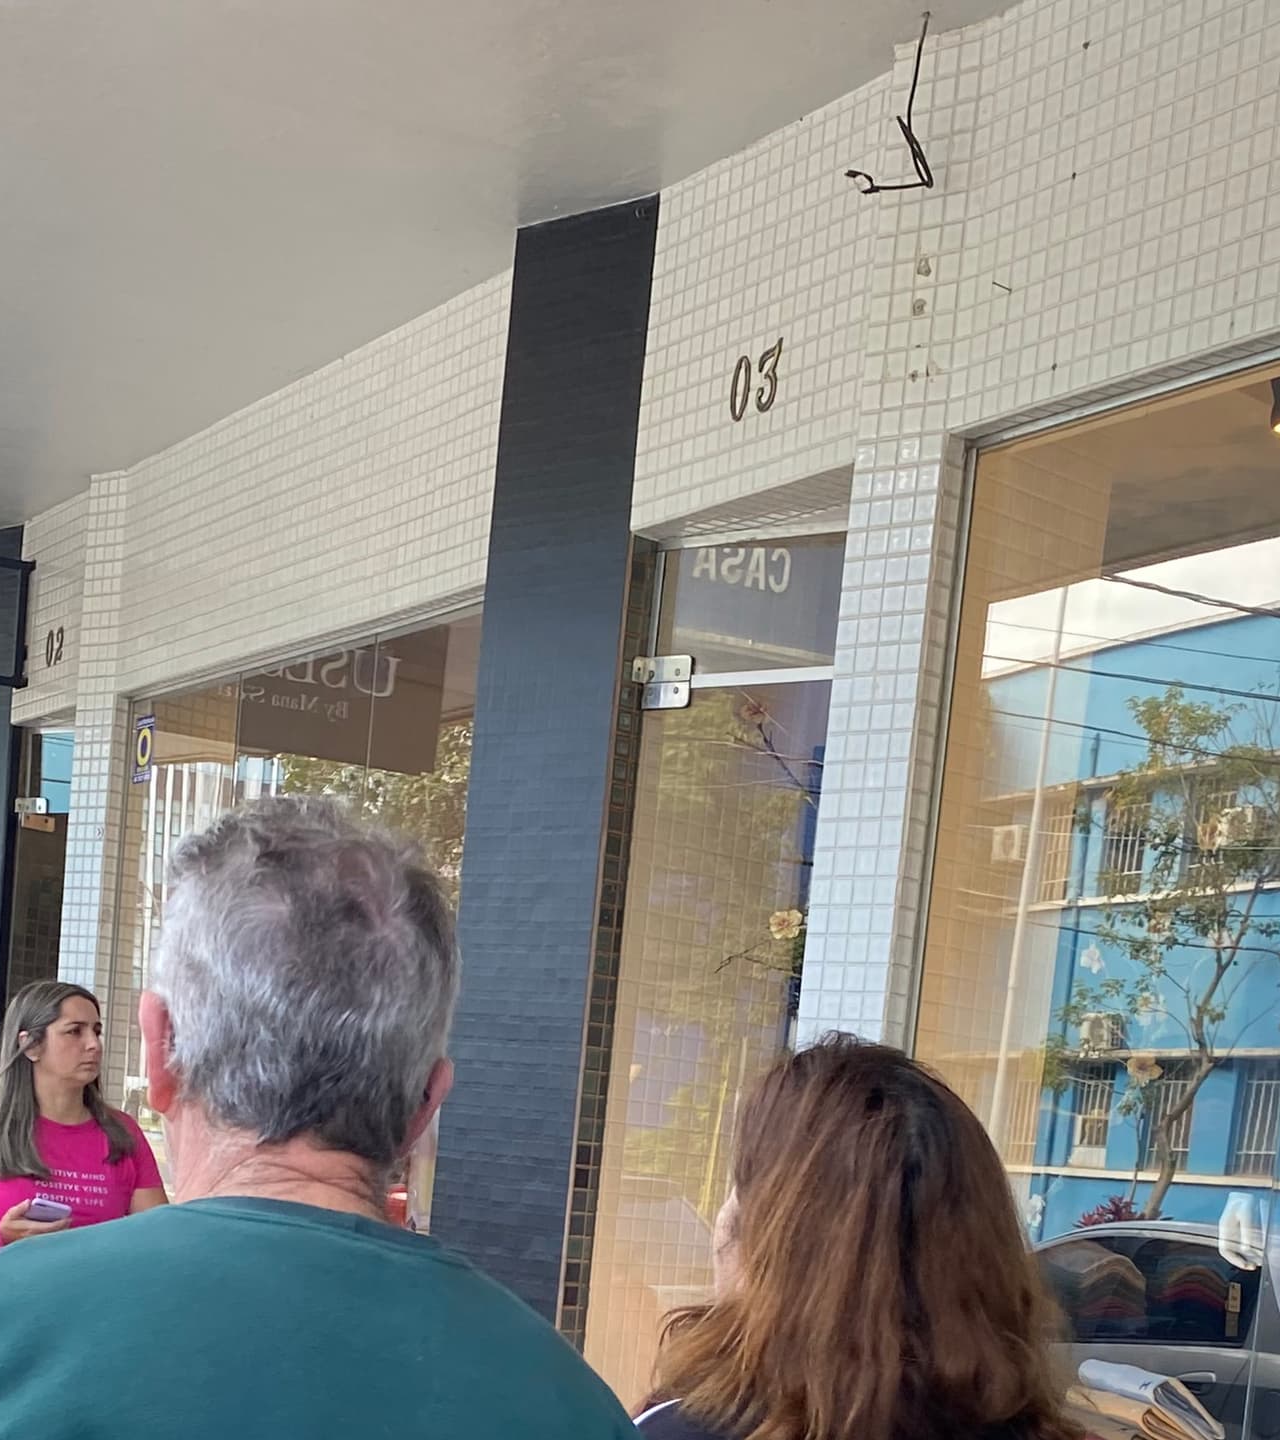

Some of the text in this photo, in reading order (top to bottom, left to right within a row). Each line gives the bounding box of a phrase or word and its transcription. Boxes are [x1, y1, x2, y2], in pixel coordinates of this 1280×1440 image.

[729, 336, 785, 423] 03
[45, 626, 65, 668] 02
[81, 1173, 106, 1182] MIND
[35, 1180, 109, 1195] POSITIVE VIBES
[35, 1192, 105, 1208] POSITIVE LIFE
